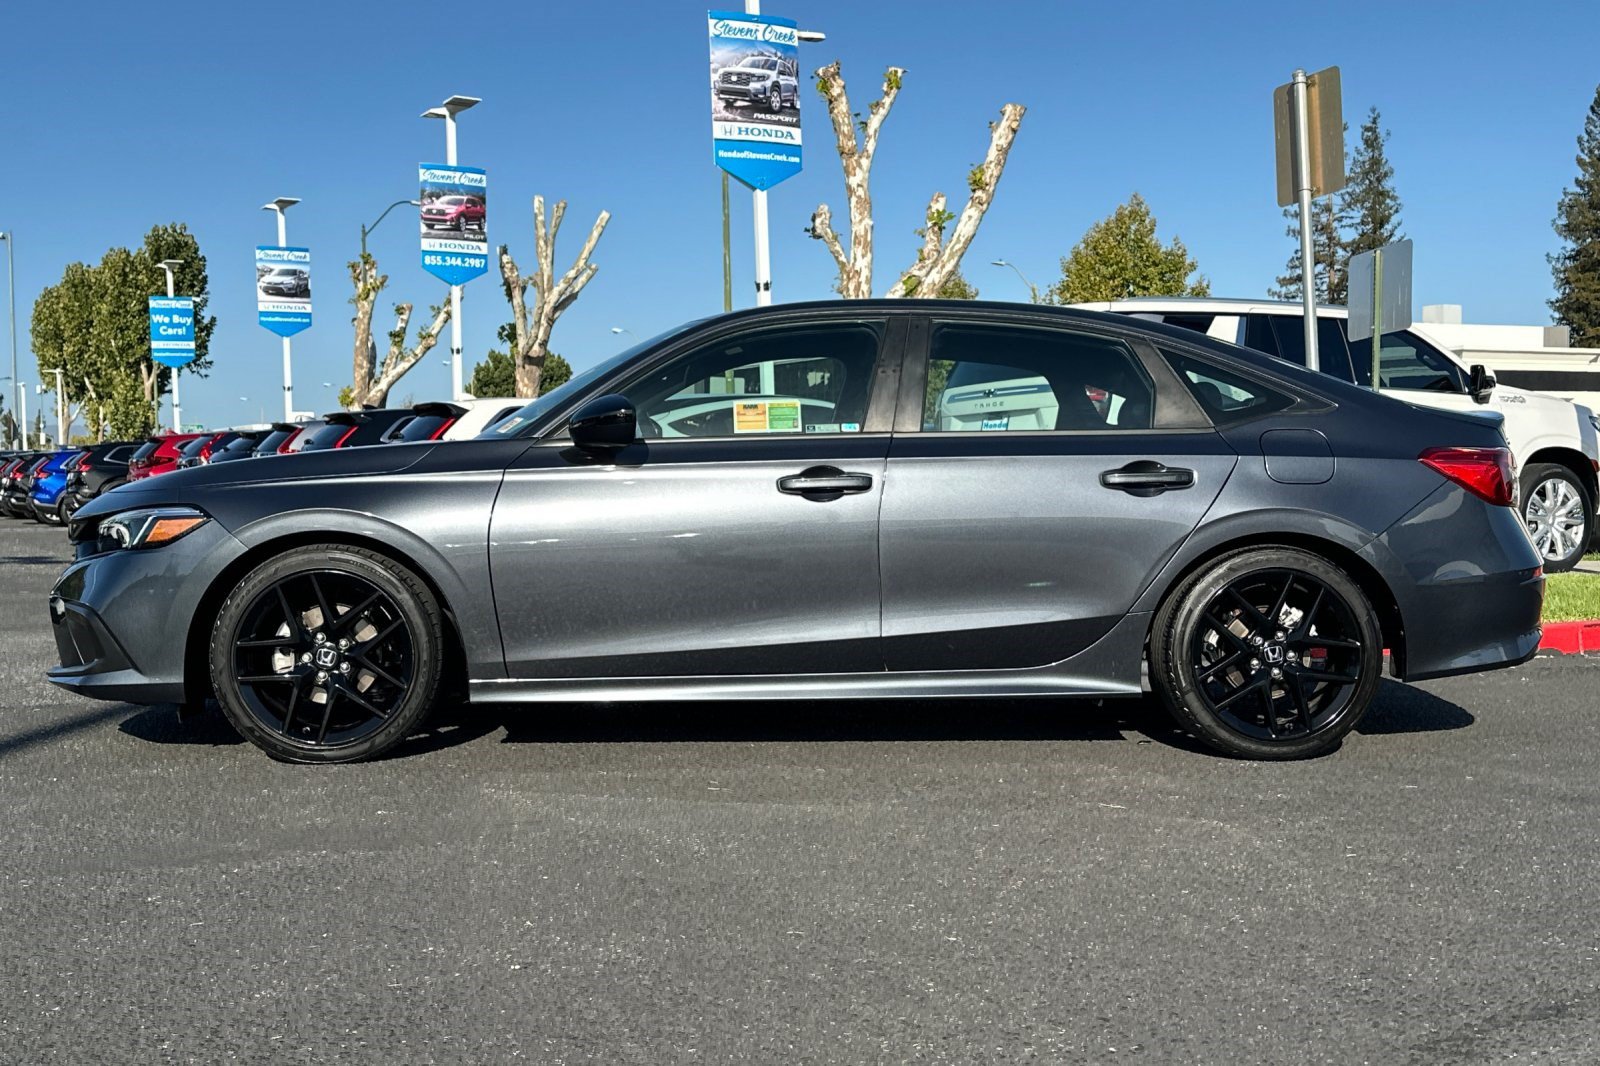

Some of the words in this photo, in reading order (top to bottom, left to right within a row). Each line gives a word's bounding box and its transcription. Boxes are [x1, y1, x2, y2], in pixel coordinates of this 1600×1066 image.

[712, 20, 759, 40] Stevens
[762, 24, 796, 43] Creek
[753, 113, 798, 122] PASSPORT
[737, 127, 795, 140] HONDA
[718, 150, 800, 162] HondaofStevensCreek.com
[439, 242, 483, 251] HONDA
[424, 255, 485, 268] 855.344.2987
[151, 314, 170, 323] We
[172, 314, 192, 326] Buy
[159, 326, 186, 335] Cars!
[974, 401, 1004, 409] TAHOE
[983, 421, 1008, 430] Honda
